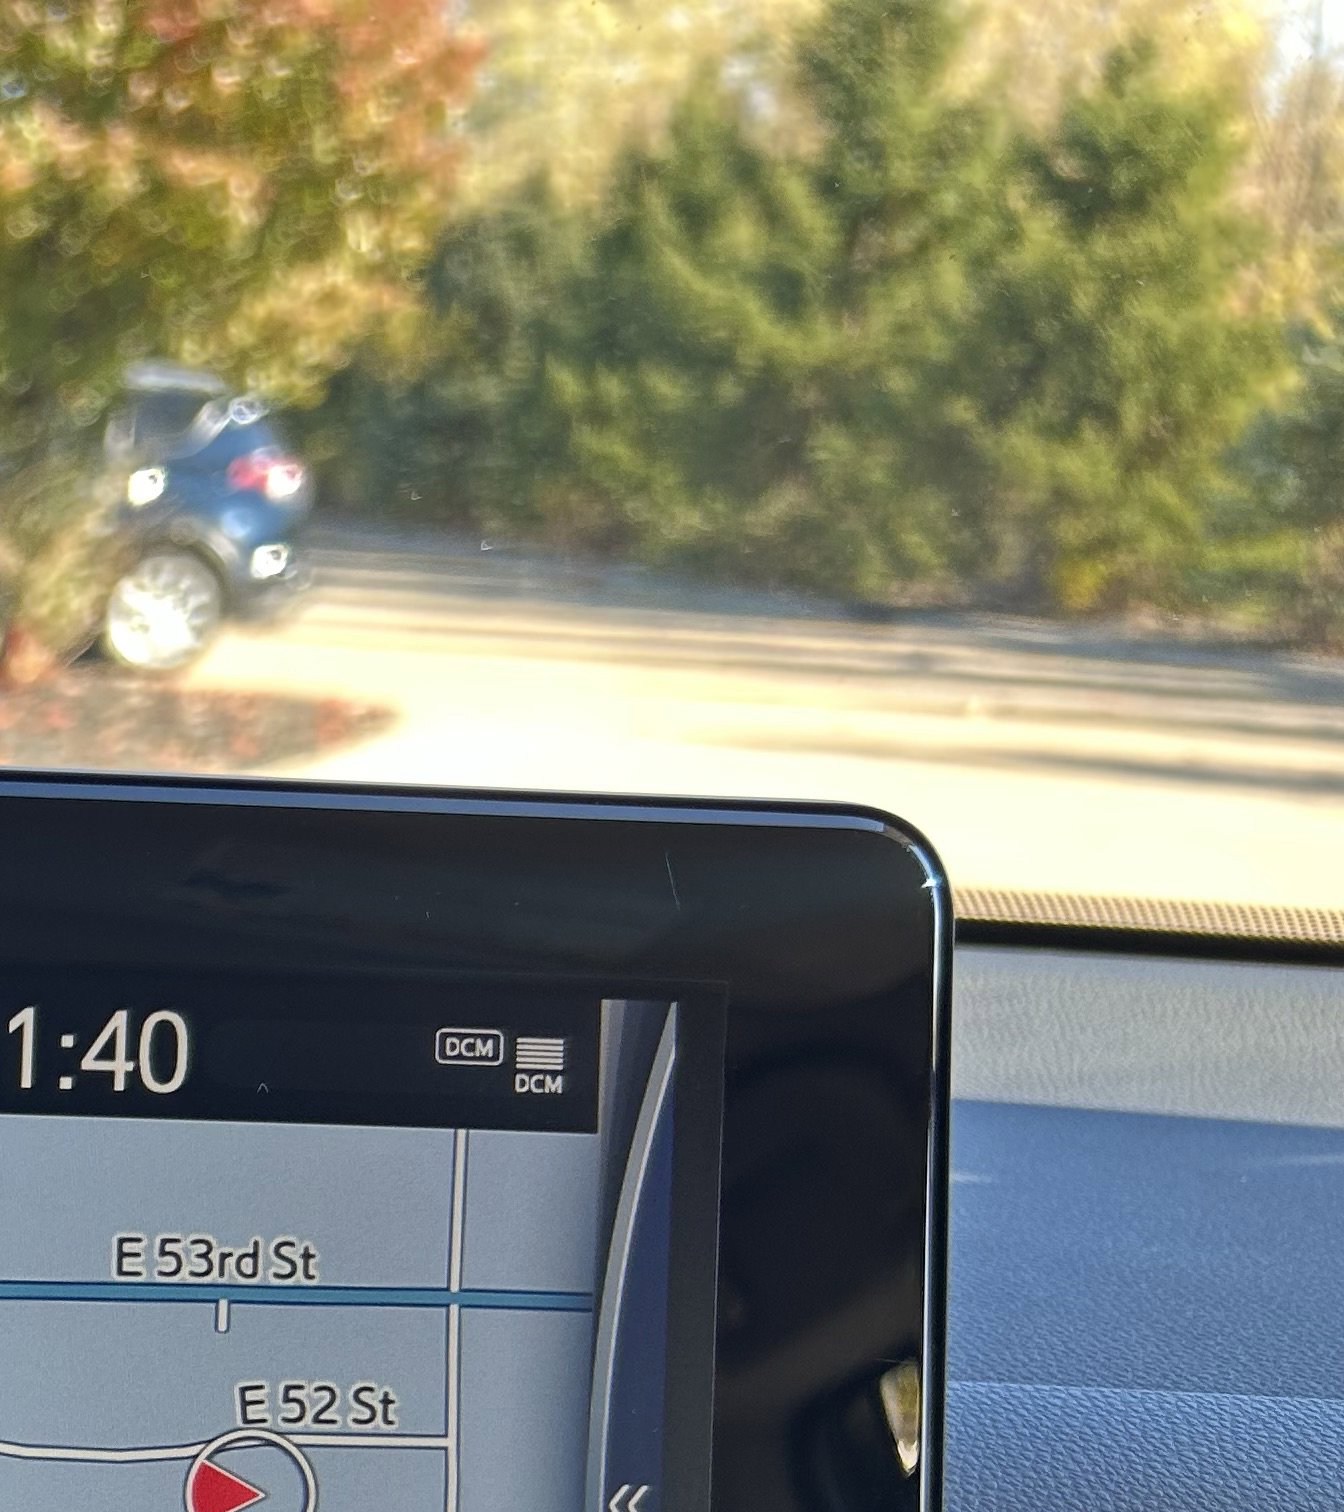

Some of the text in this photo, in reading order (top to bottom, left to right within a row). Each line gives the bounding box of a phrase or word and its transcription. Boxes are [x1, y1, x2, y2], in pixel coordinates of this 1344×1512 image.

[7, 1005, 190, 1095] 1:40
[444, 1036, 494, 1058] DCM
[514, 1073, 564, 1094] DCM
[116, 1236, 317, 1281] E 53rd St
[239, 1383, 396, 1427] E 52 St
